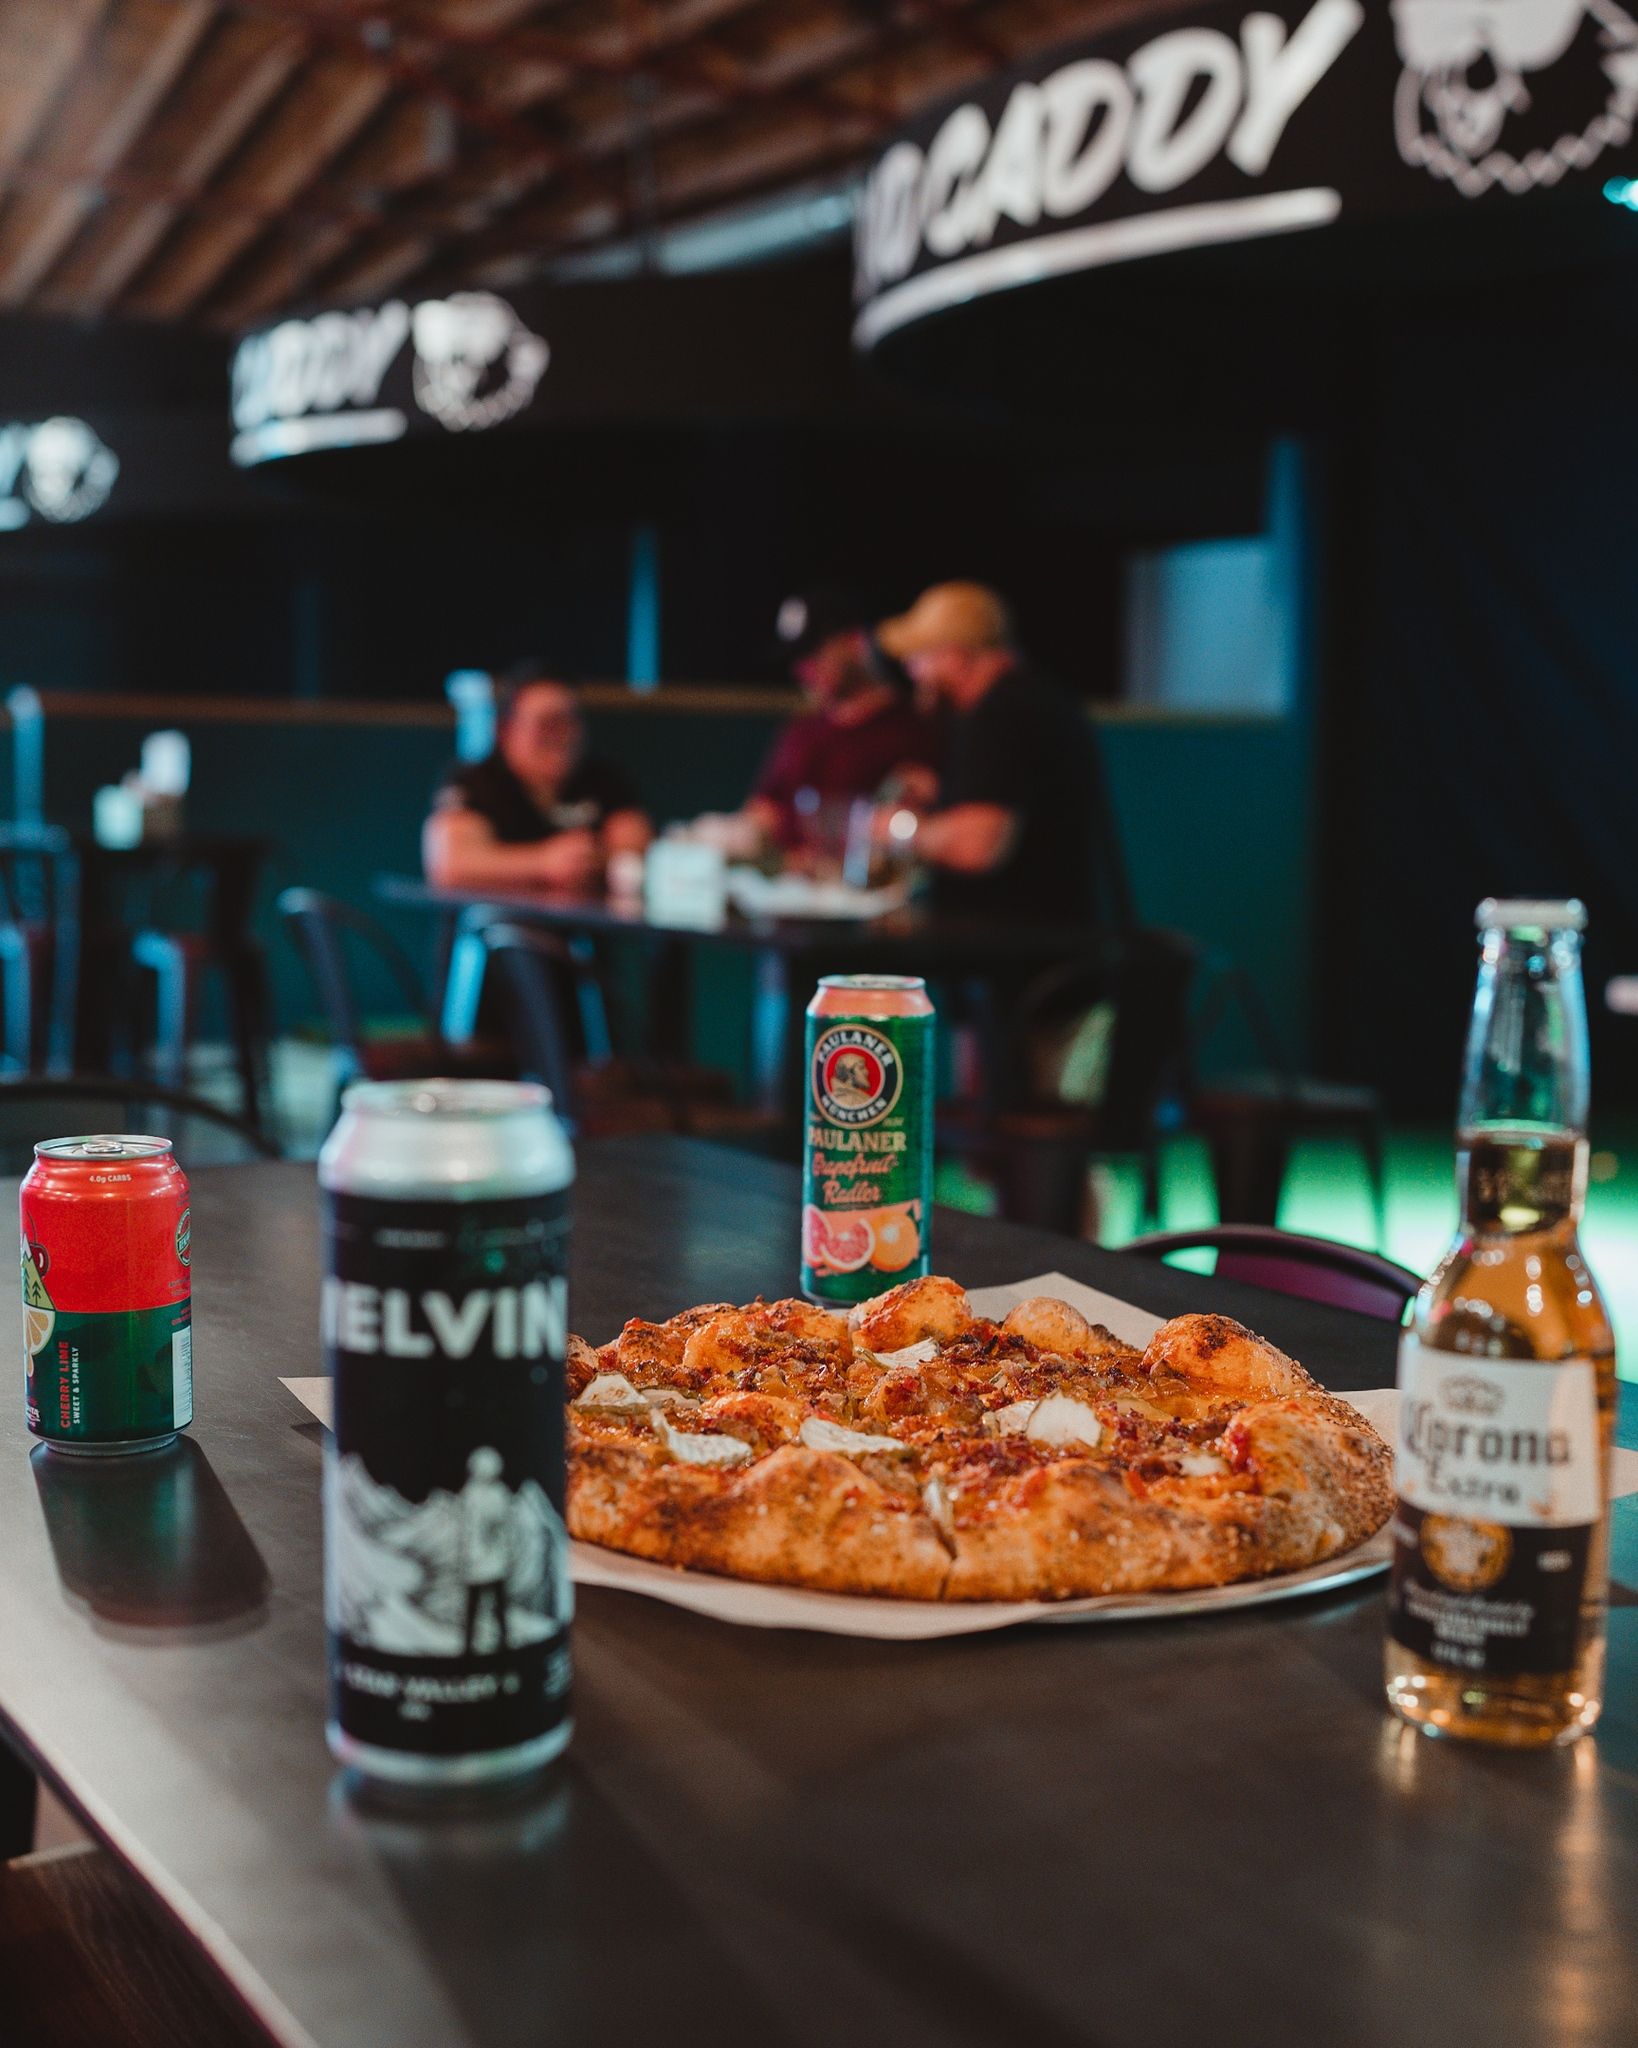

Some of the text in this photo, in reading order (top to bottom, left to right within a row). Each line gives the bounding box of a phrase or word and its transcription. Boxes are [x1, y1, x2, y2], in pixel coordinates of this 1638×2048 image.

[818, 1031, 894, 1067] PAULANER
[89, 1174, 132, 1184] 4.0g CARBS
[823, 1180, 880, 1205] Radler
[321, 1275, 569, 1362] ELVIN
[71, 1346, 80, 1384] SPARKLY
[58, 1341, 71, 1429] CHERRY LIME
[72, 1396, 81, 1425] SWEET
